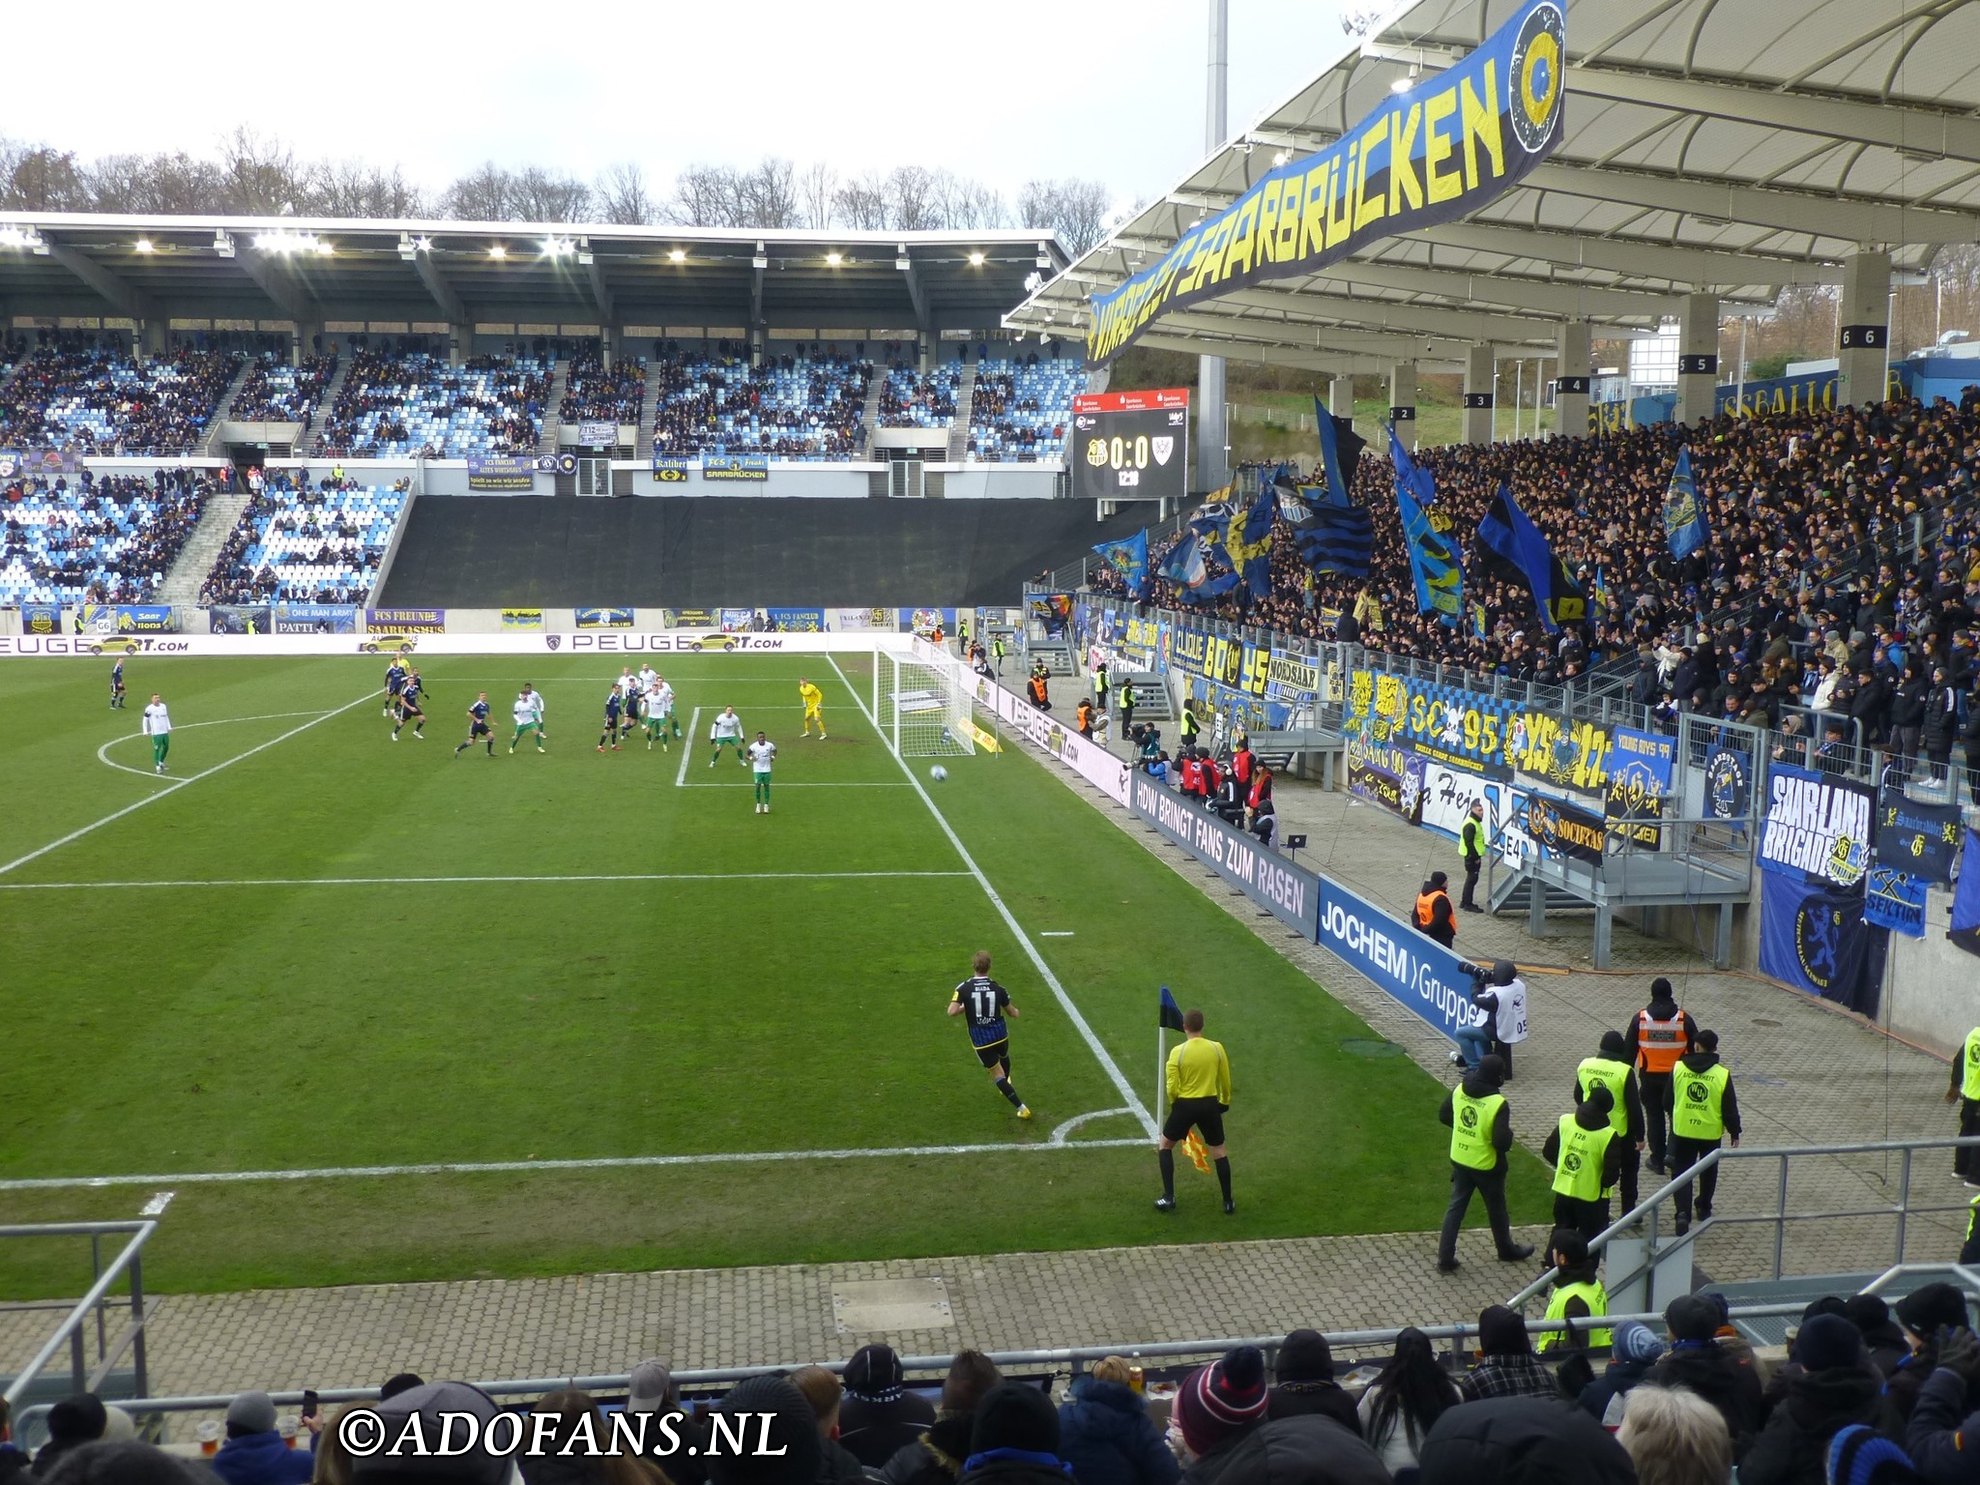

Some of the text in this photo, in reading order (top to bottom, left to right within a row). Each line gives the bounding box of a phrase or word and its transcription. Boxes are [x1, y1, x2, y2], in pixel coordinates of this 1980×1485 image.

[1176, 58, 1505, 296] SAARBRÜCKEN
[1842, 331, 1850, 344] 6
[1865, 331, 1875, 343] 6
[1697, 359, 1706, 370] 5
[1573, 380, 1581, 390] 4
[1477, 396, 1484, 405] 3
[1401, 410, 1408, 418] 2
[1111, 436, 1148, 469] 0:0
[708, 459, 726, 468] FCS
[706, 471, 766, 479] SAARBRÜCKEN
[292, 609, 354, 618] ONE MAN ARMY
[375, 611, 437, 622] FCS FREUNDE
[97, 623, 110, 632] G6
[279, 623, 313, 633] PATTI
[1269, 659, 1316, 689] NORDSAAR
[1411, 695, 1443, 738] SC
[1464, 709, 1498, 754] 95
[1523, 713, 1556, 775] YS
[1618, 734, 1638, 752] YOUNG
[1638, 741, 1656, 756] BOYS
[1767, 775, 1870, 845] SAARLAND
[1506, 836, 1520, 859] E4
[1762, 820, 1836, 877] BRIGADE
[1159, 793, 1194, 842] BRINGT
[1195, 817, 1224, 864] FANS
[1225, 836, 1254, 885] ZUM
[1258, 856, 1305, 919] RASEN
[1321, 900, 1480, 1029] JOCHEM Gruppe
[971, 991, 996, 1018] 11
[1685, 1102, 1709, 1112] SERVICE
[1457, 1125, 1477, 1138] SERVICE
[1574, 1132, 1586, 1141] 128
